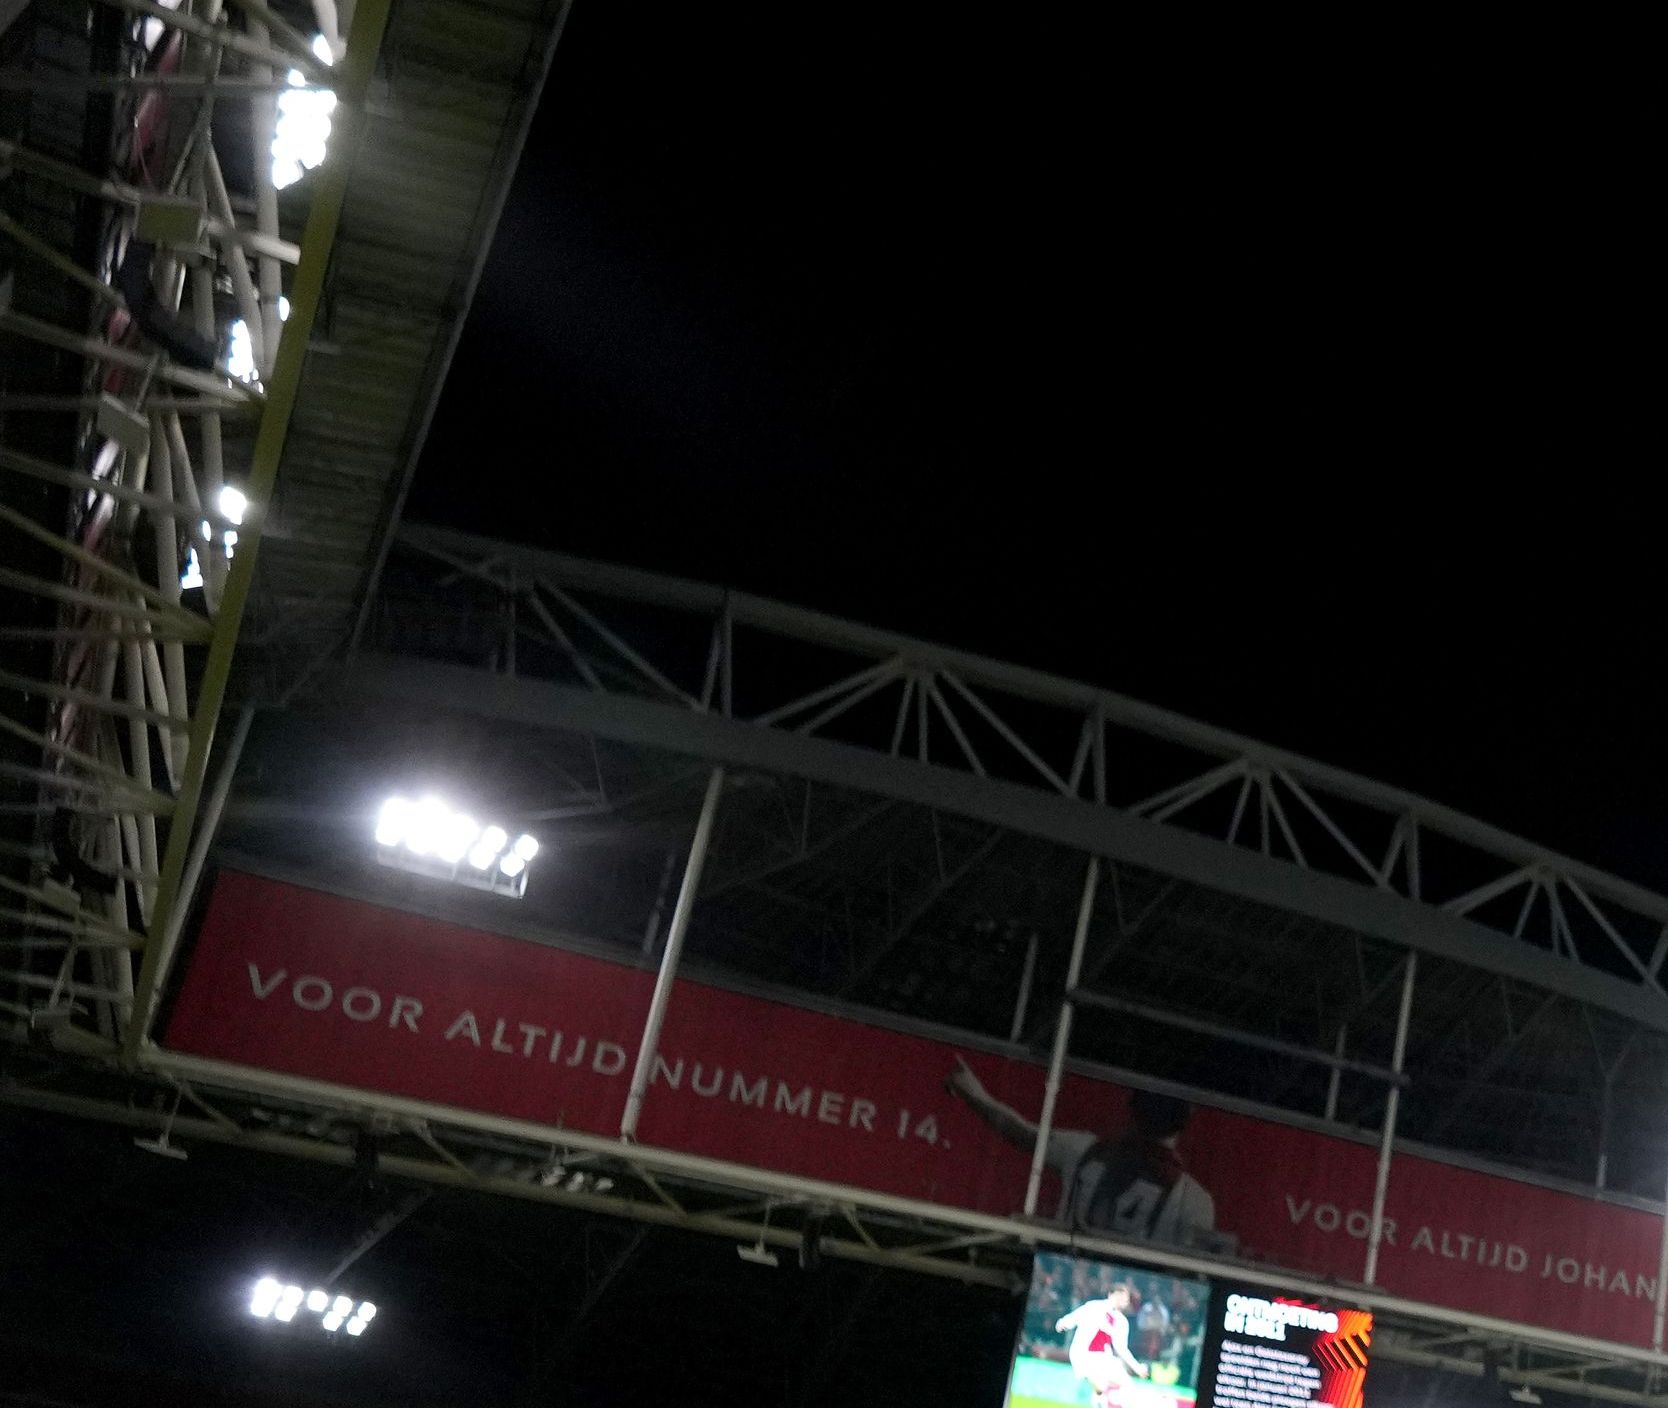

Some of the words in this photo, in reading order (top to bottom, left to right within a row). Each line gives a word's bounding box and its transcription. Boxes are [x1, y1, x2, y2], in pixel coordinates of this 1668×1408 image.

[247, 962, 425, 1033] VOOR
[443, 1008, 628, 1076] ALTIJD
[649, 1054, 877, 1132] NUMMER
[896, 1108, 951, 1150] 14.
[1285, 1193, 1398, 1246] VOOR
[1409, 1226, 1529, 1273] ALTIJD
[1540, 1252, 1659, 1302] JOHAN
